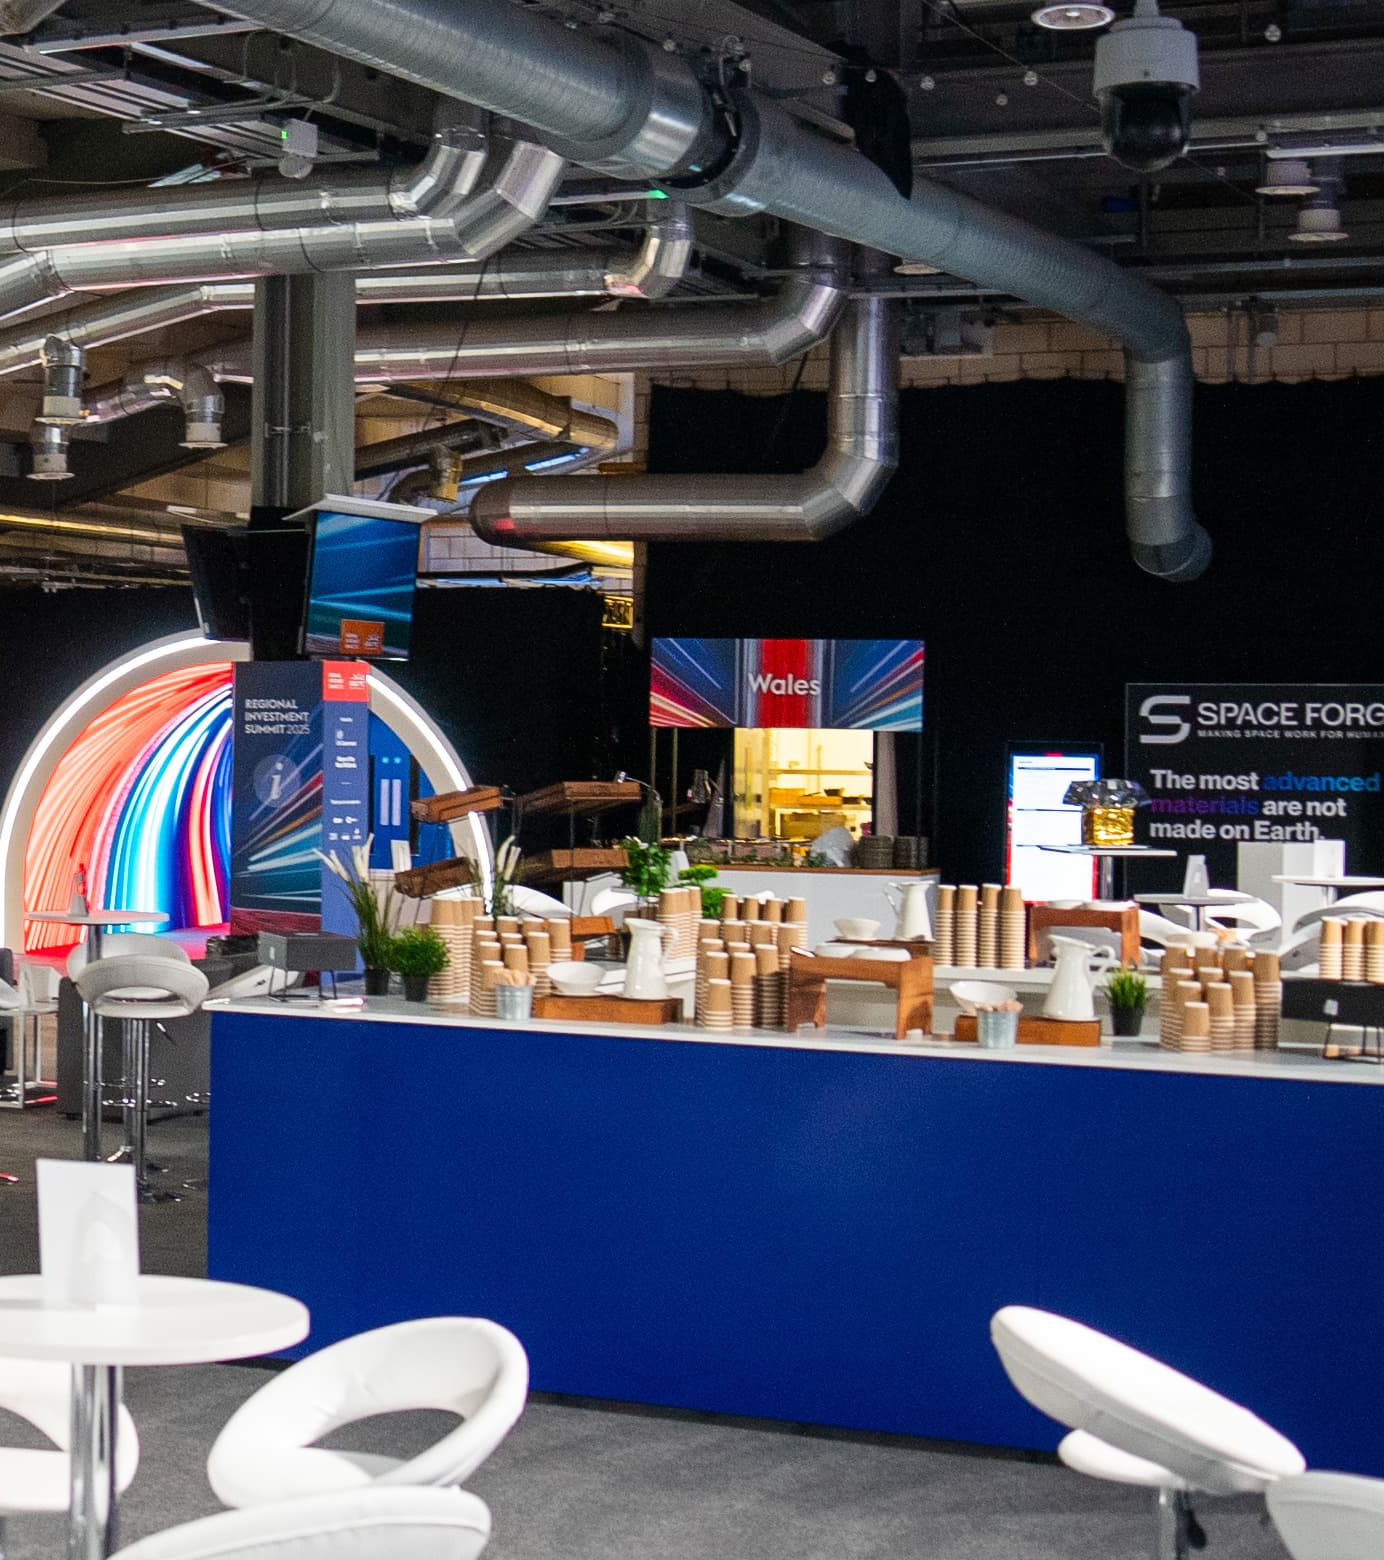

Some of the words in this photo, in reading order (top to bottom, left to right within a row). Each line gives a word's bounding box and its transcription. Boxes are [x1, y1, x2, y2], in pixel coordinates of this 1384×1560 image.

[748, 673, 821, 695] Wales
[244, 698, 298, 710] REGIONAL
[1197, 702, 1299, 726] SPACE
[1305, 702, 1384, 726] FORG
[244, 711, 310, 722] INVESTMENT
[244, 723, 285, 735] SUMMIT
[286, 723, 310, 735] 2025
[1197, 730, 1242, 739] MAKING
[1244, 730, 1281, 739] SPACE
[1284, 730, 1316, 739] WORK
[1320, 730, 1344, 739] FOR
[1149, 769, 1196, 790] The
[1199, 772, 1260, 790] most
[1262, 771, 1381, 791] advanced
[1150, 797, 1260, 815] materials
[1262, 800, 1303, 816] are
[1306, 798, 1347, 817] not
[1149, 819, 1216, 839] made
[1219, 825, 1250, 839] on
[1254, 820, 1325, 840] Earth.
